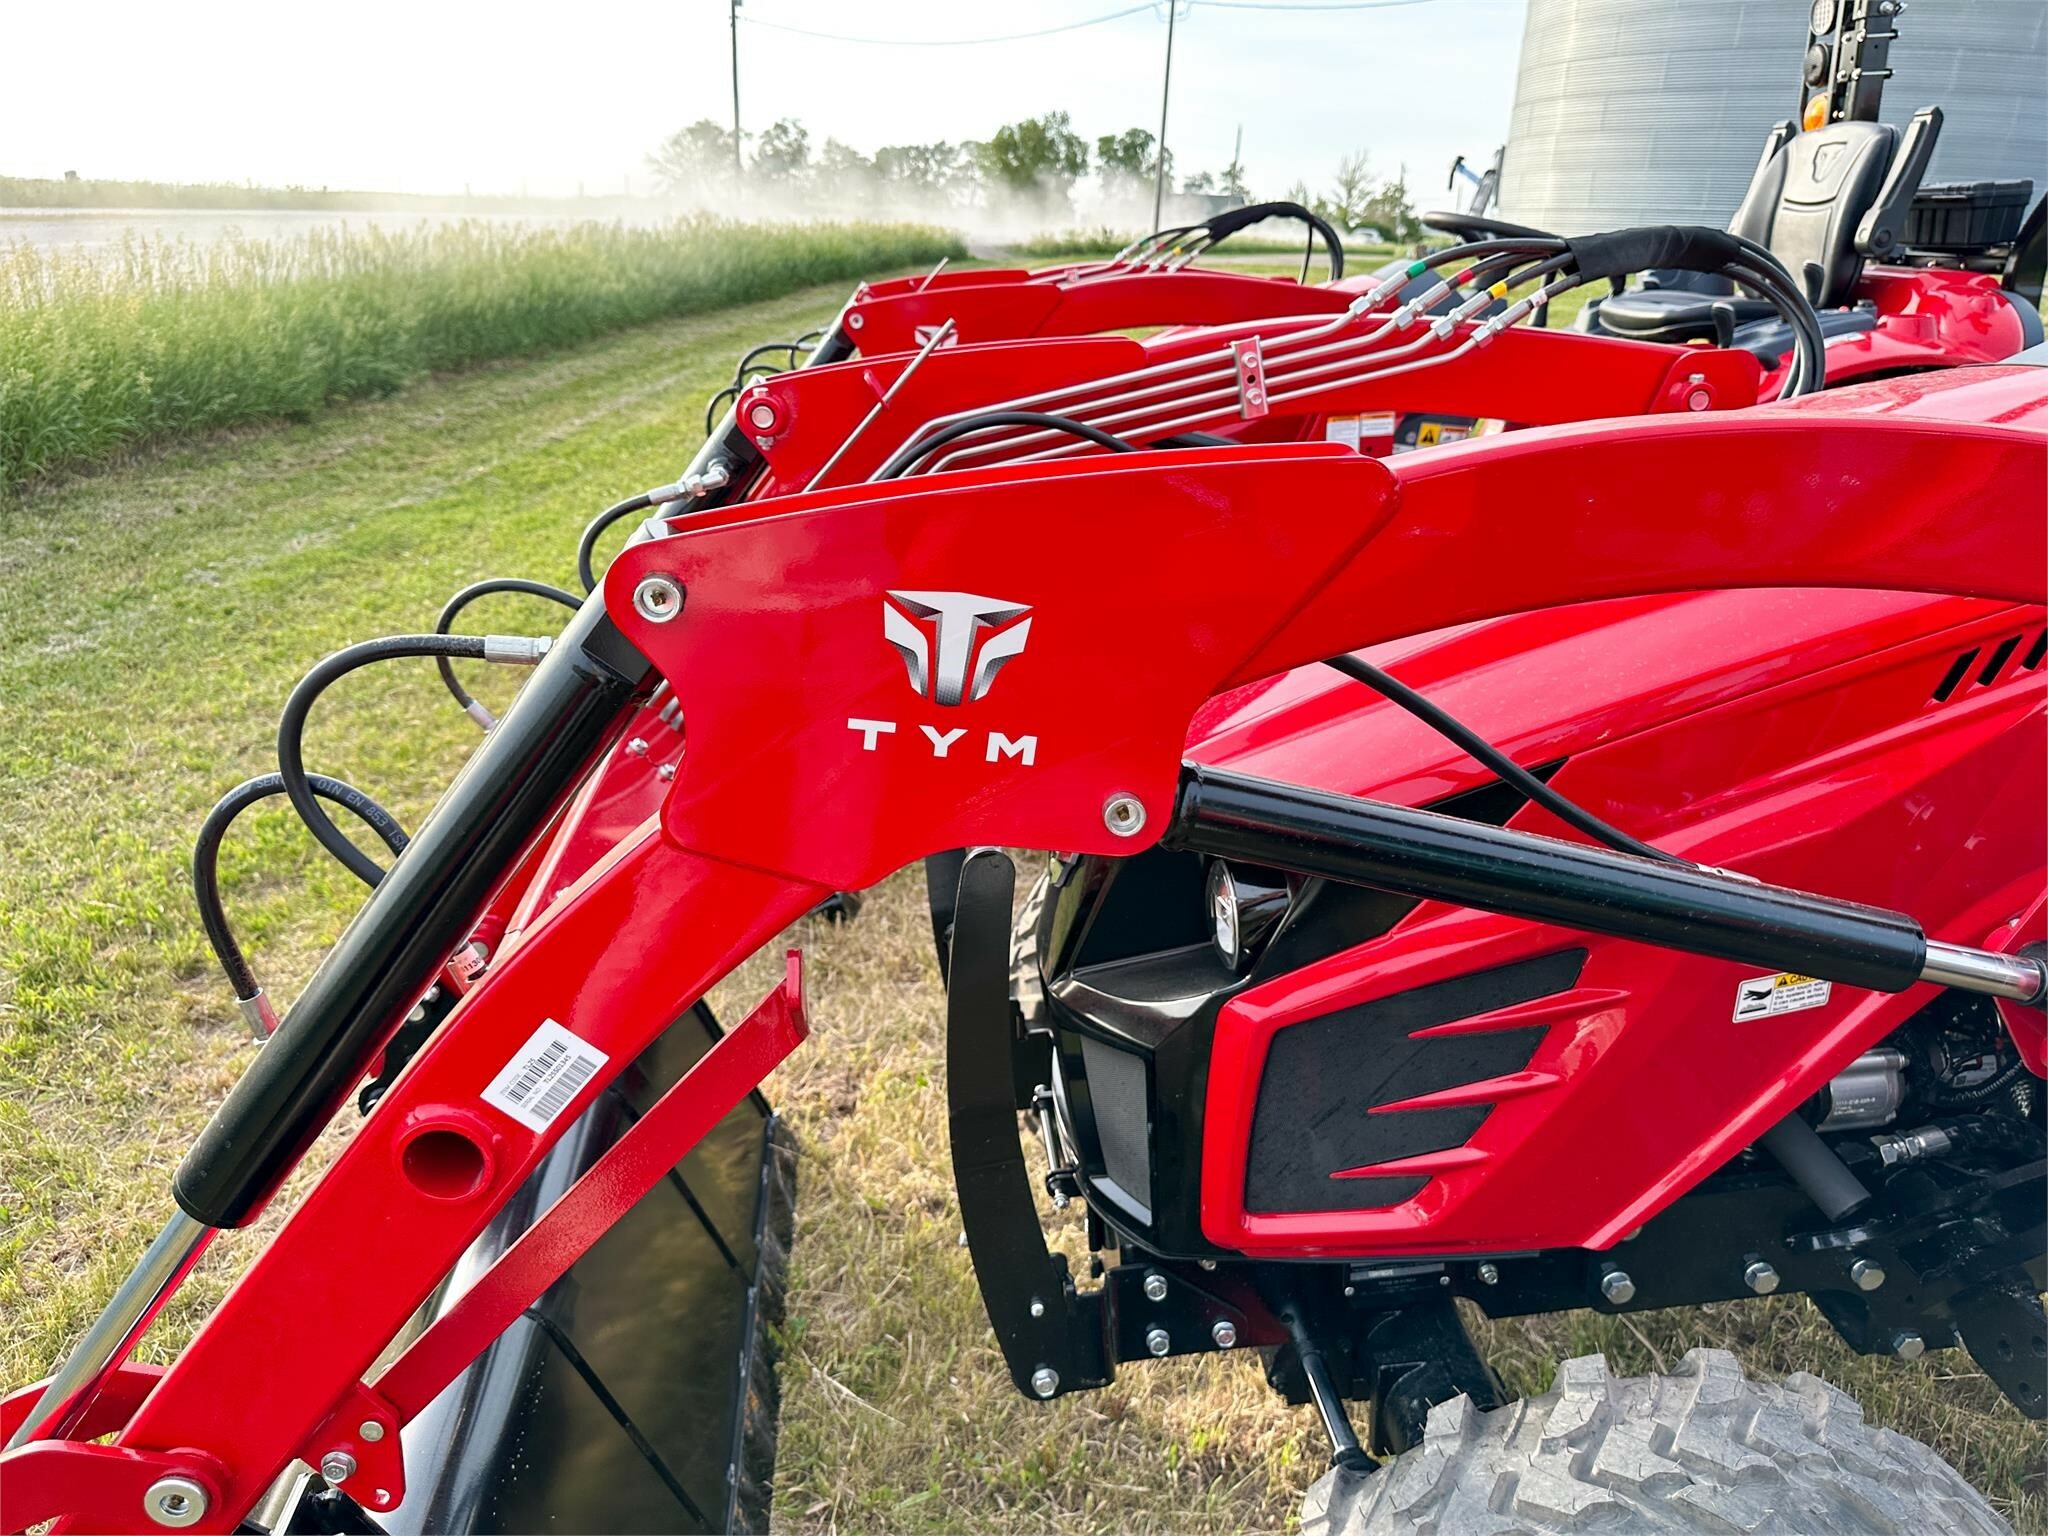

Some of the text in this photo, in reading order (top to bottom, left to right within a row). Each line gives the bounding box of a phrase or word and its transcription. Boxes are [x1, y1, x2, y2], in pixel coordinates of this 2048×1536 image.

[847, 717, 1038, 766] TYM
[346, 791, 365, 807] EN
[365, 806, 389, 827] 853
